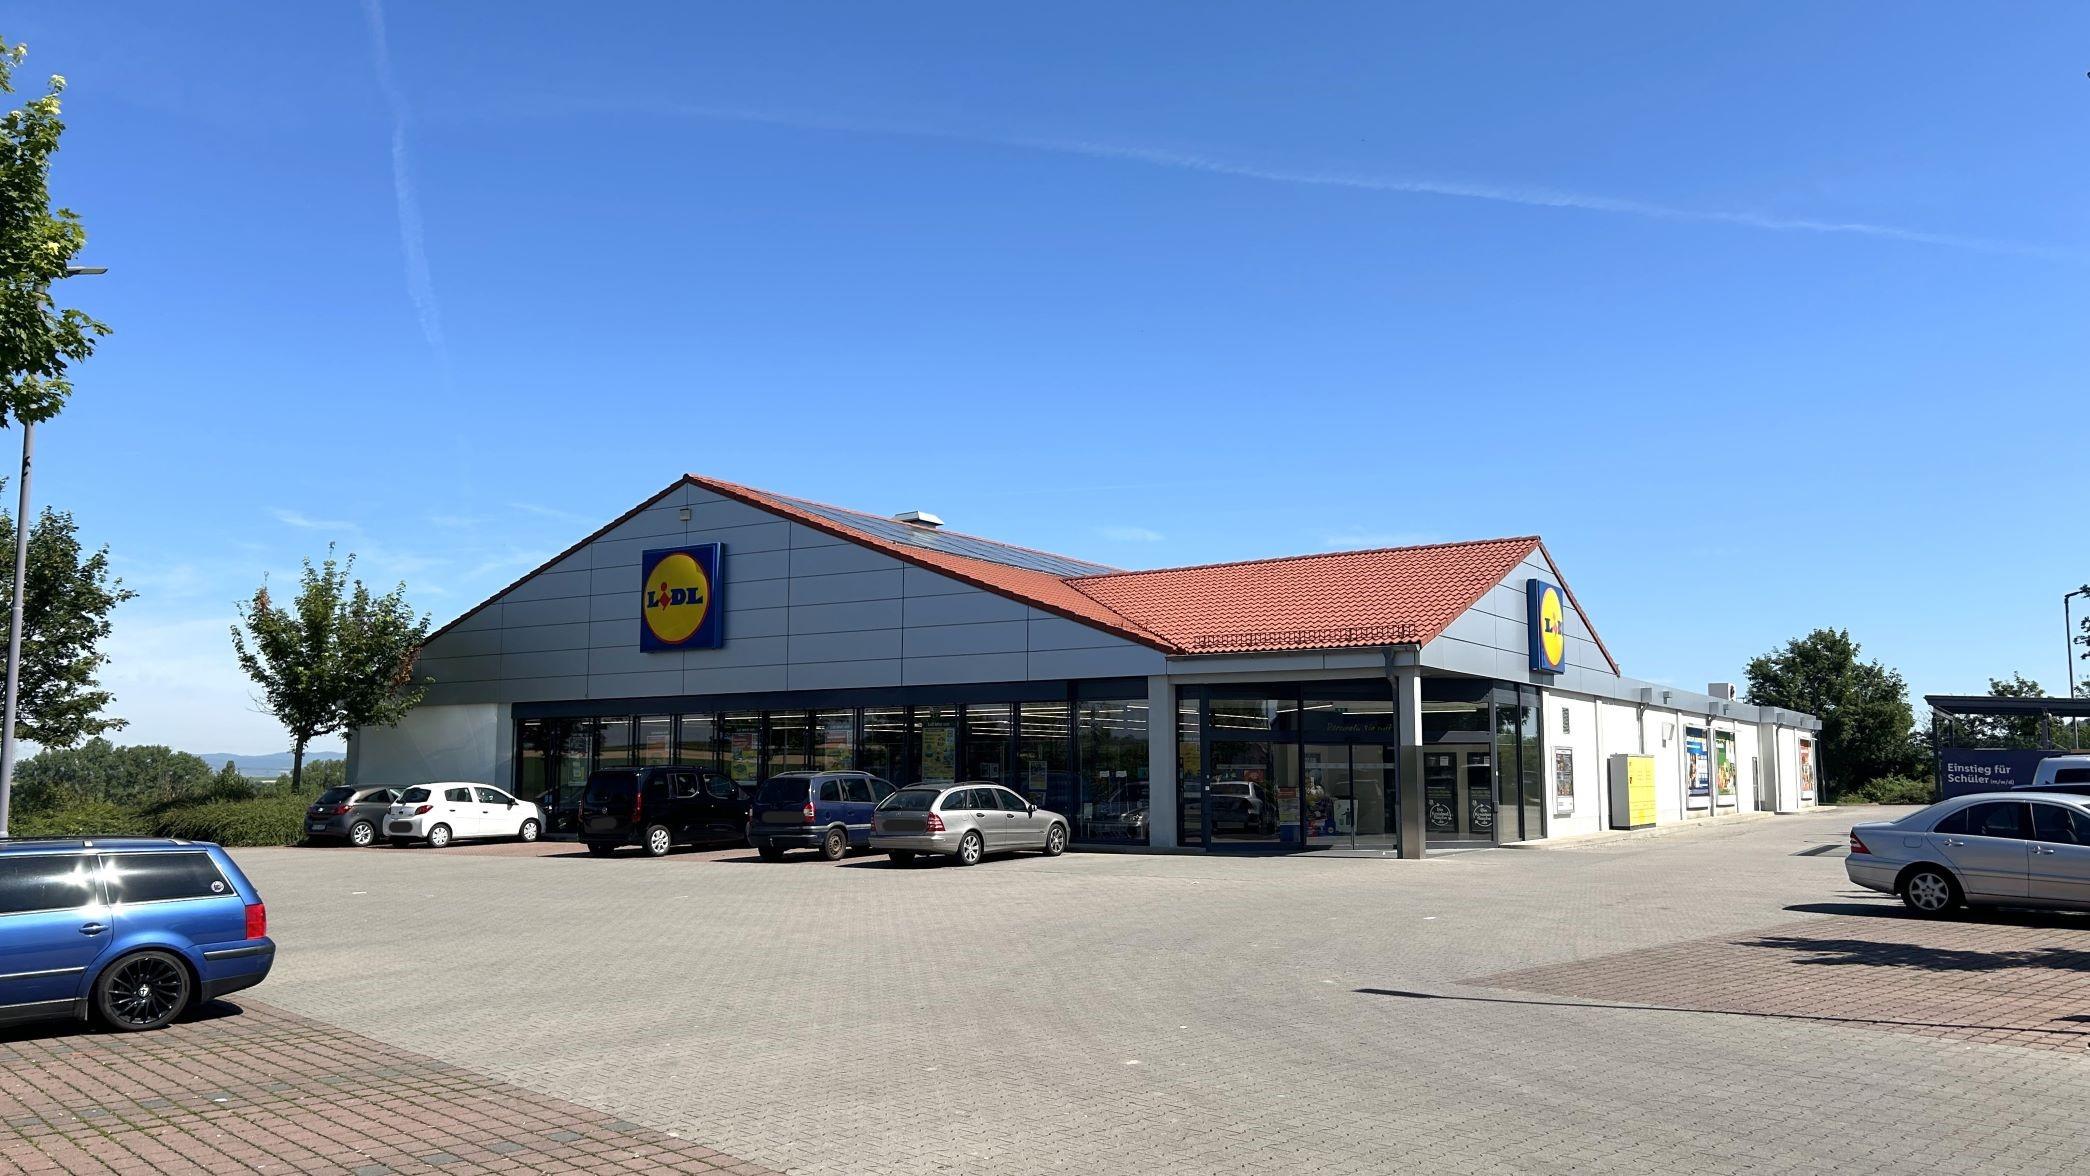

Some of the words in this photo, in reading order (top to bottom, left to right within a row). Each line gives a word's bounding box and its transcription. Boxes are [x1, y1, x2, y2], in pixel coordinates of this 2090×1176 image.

[647, 582, 704, 611] LIDL
[1947, 763, 1991, 775] Einstieg
[1994, 765, 2011, 774] für
[1947, 774, 1989, 784] Schüler
